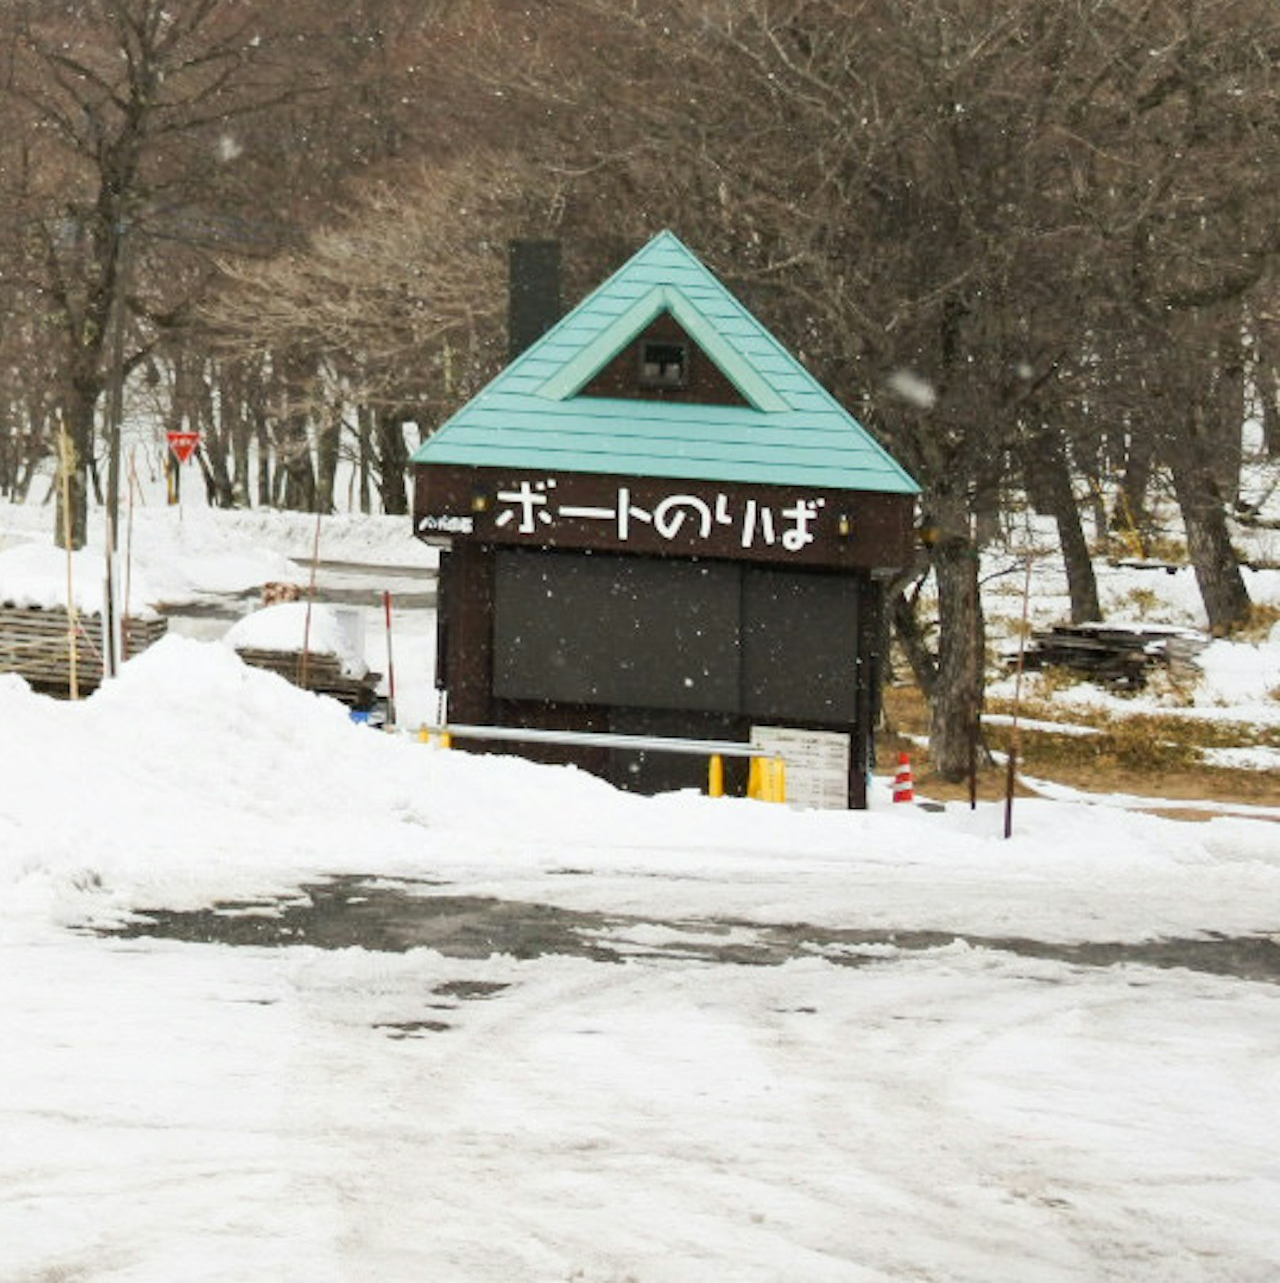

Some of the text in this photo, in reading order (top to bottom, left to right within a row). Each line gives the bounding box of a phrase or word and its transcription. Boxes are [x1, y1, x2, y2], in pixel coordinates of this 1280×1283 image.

[495, 478, 826, 551] ボートのりば
